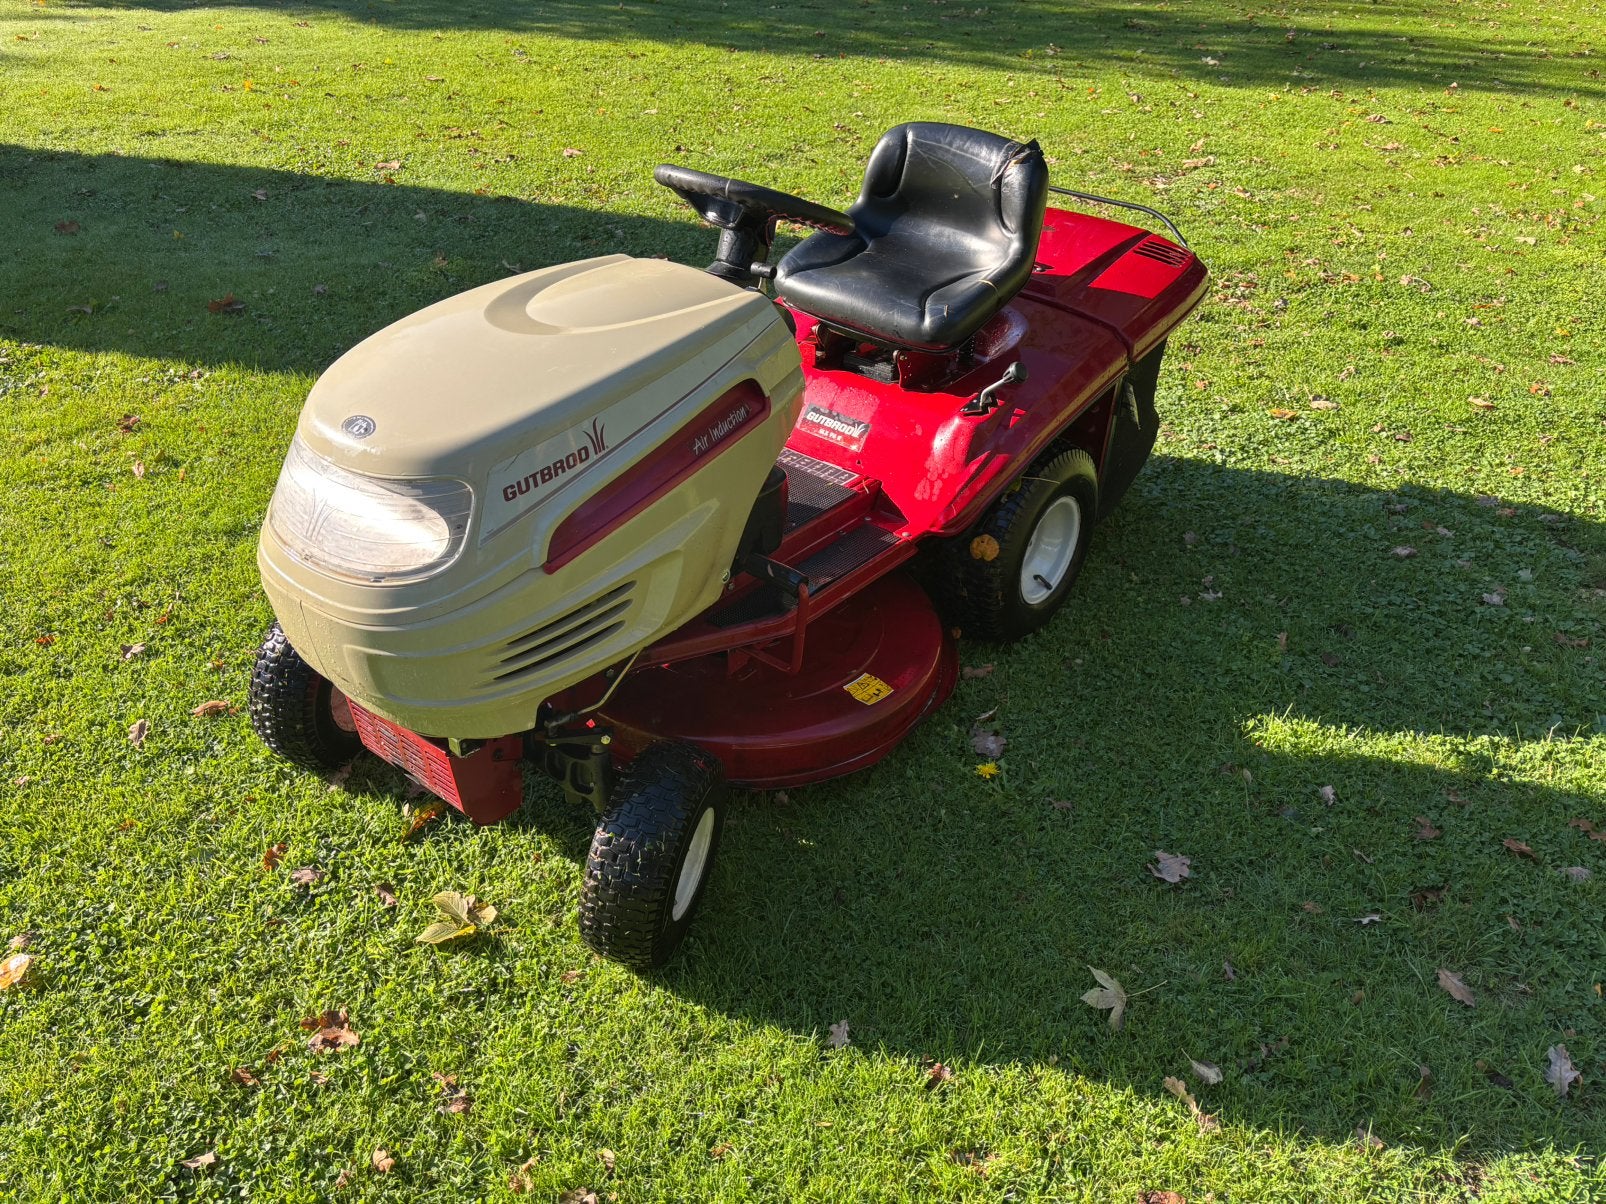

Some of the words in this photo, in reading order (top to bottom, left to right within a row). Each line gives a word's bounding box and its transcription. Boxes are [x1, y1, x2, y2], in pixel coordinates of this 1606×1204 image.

[693, 437, 709, 455] Air
[708, 405, 747, 442] Induction
[806, 411, 856, 437] GUTBROD
[503, 445, 590, 502] GUTBROD
